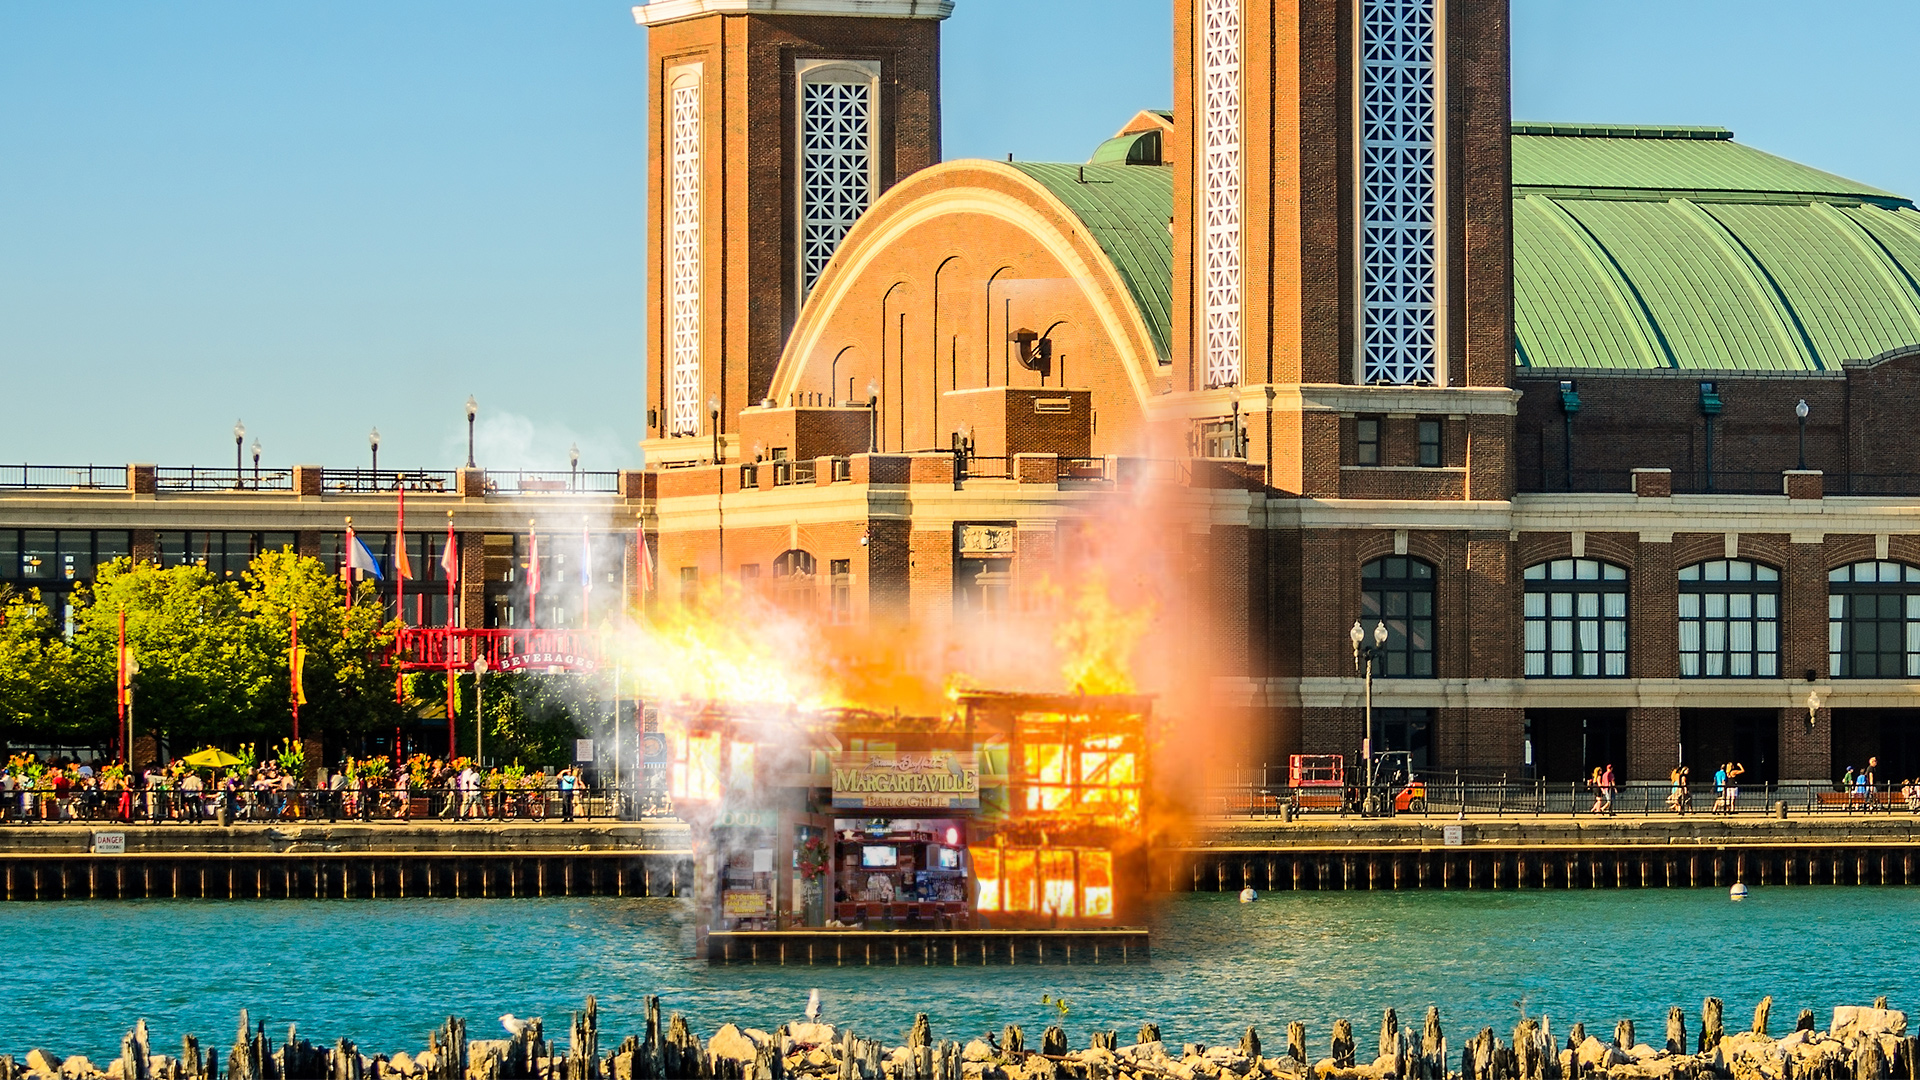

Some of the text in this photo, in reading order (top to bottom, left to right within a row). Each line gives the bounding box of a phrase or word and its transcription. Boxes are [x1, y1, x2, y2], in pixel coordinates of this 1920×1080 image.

[501, 653, 595, 669] BEVERAGES
[835, 769, 976, 792] MARGARITAVILLE
[865, 796, 946, 807] BAR & GRILL
[721, 812, 761, 826] OOD
[98, 836, 123, 844] DANGER
